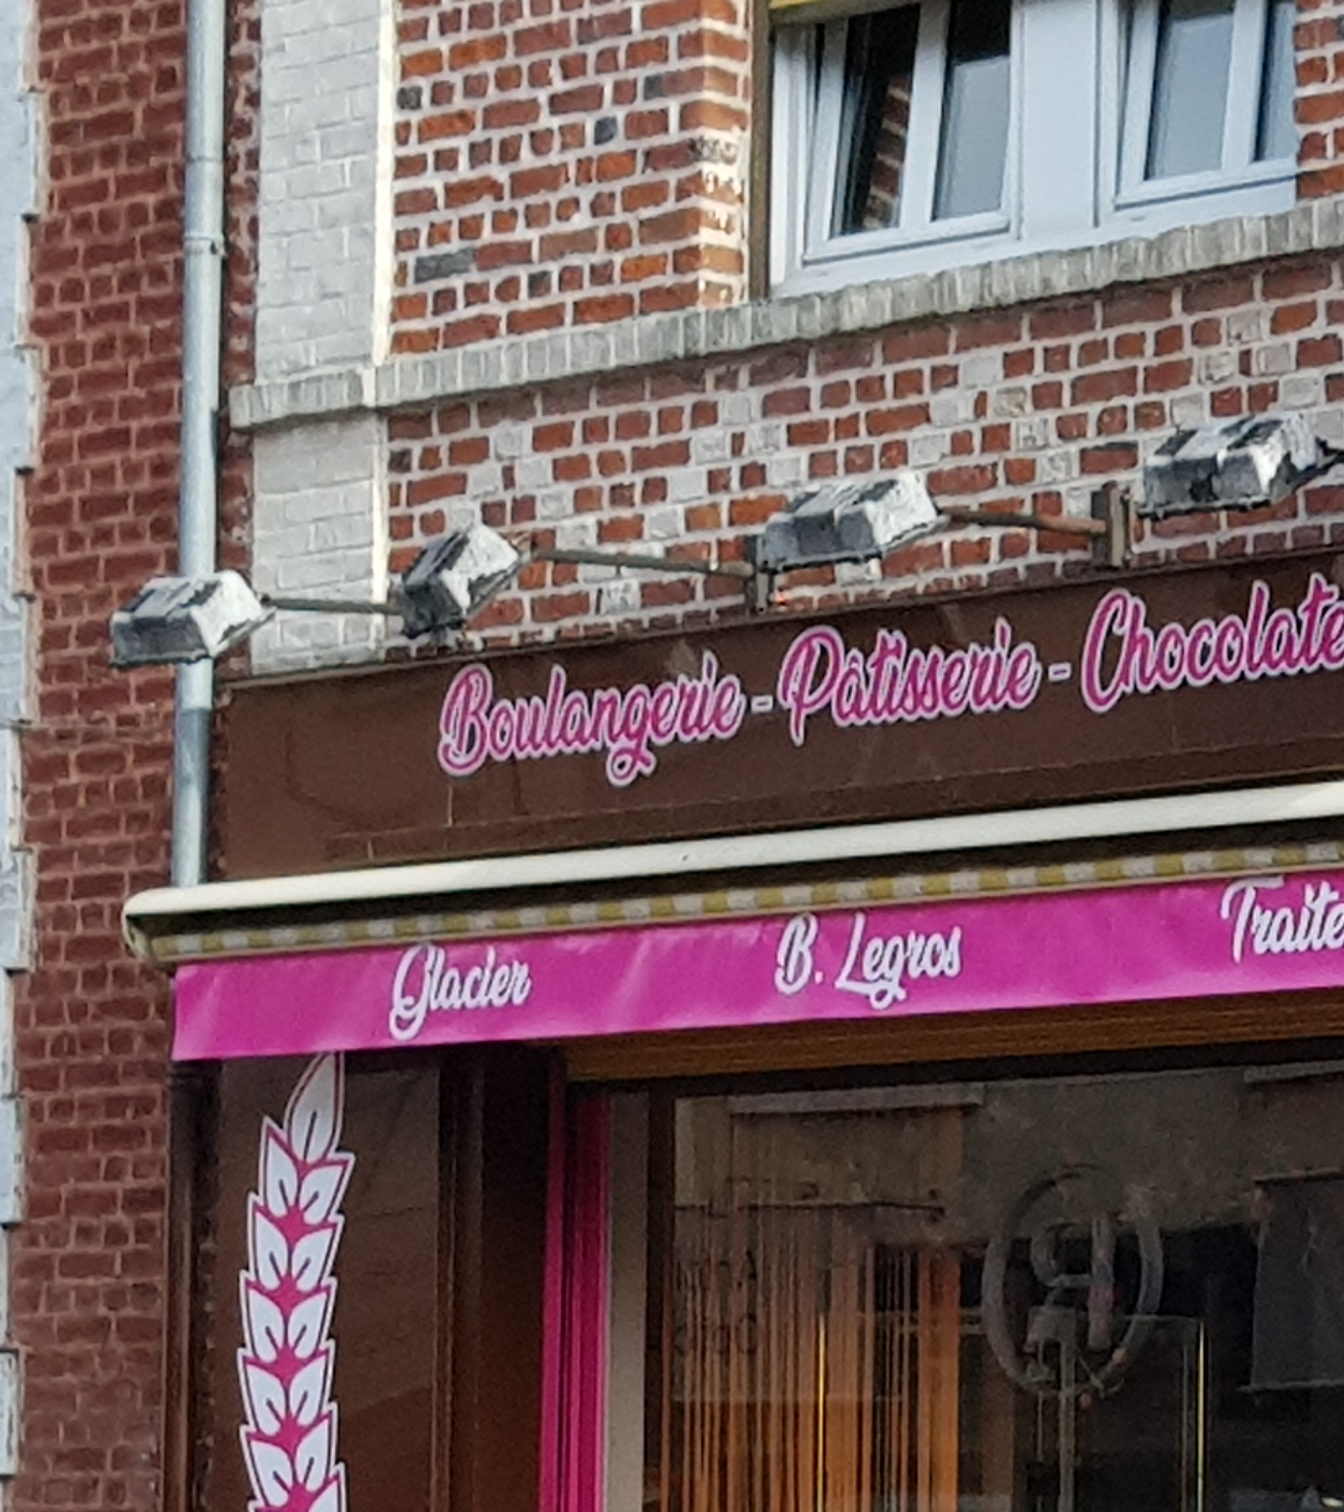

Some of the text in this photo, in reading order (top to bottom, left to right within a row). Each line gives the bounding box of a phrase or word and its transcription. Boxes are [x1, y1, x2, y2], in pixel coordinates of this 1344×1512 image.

[438, 650, 745, 786] Boulangerie
[777, 616, 1042, 747] Pâtisserie
[388, 941, 532, 1041] Glacier
[774, 912, 962, 1011] B. Legros
